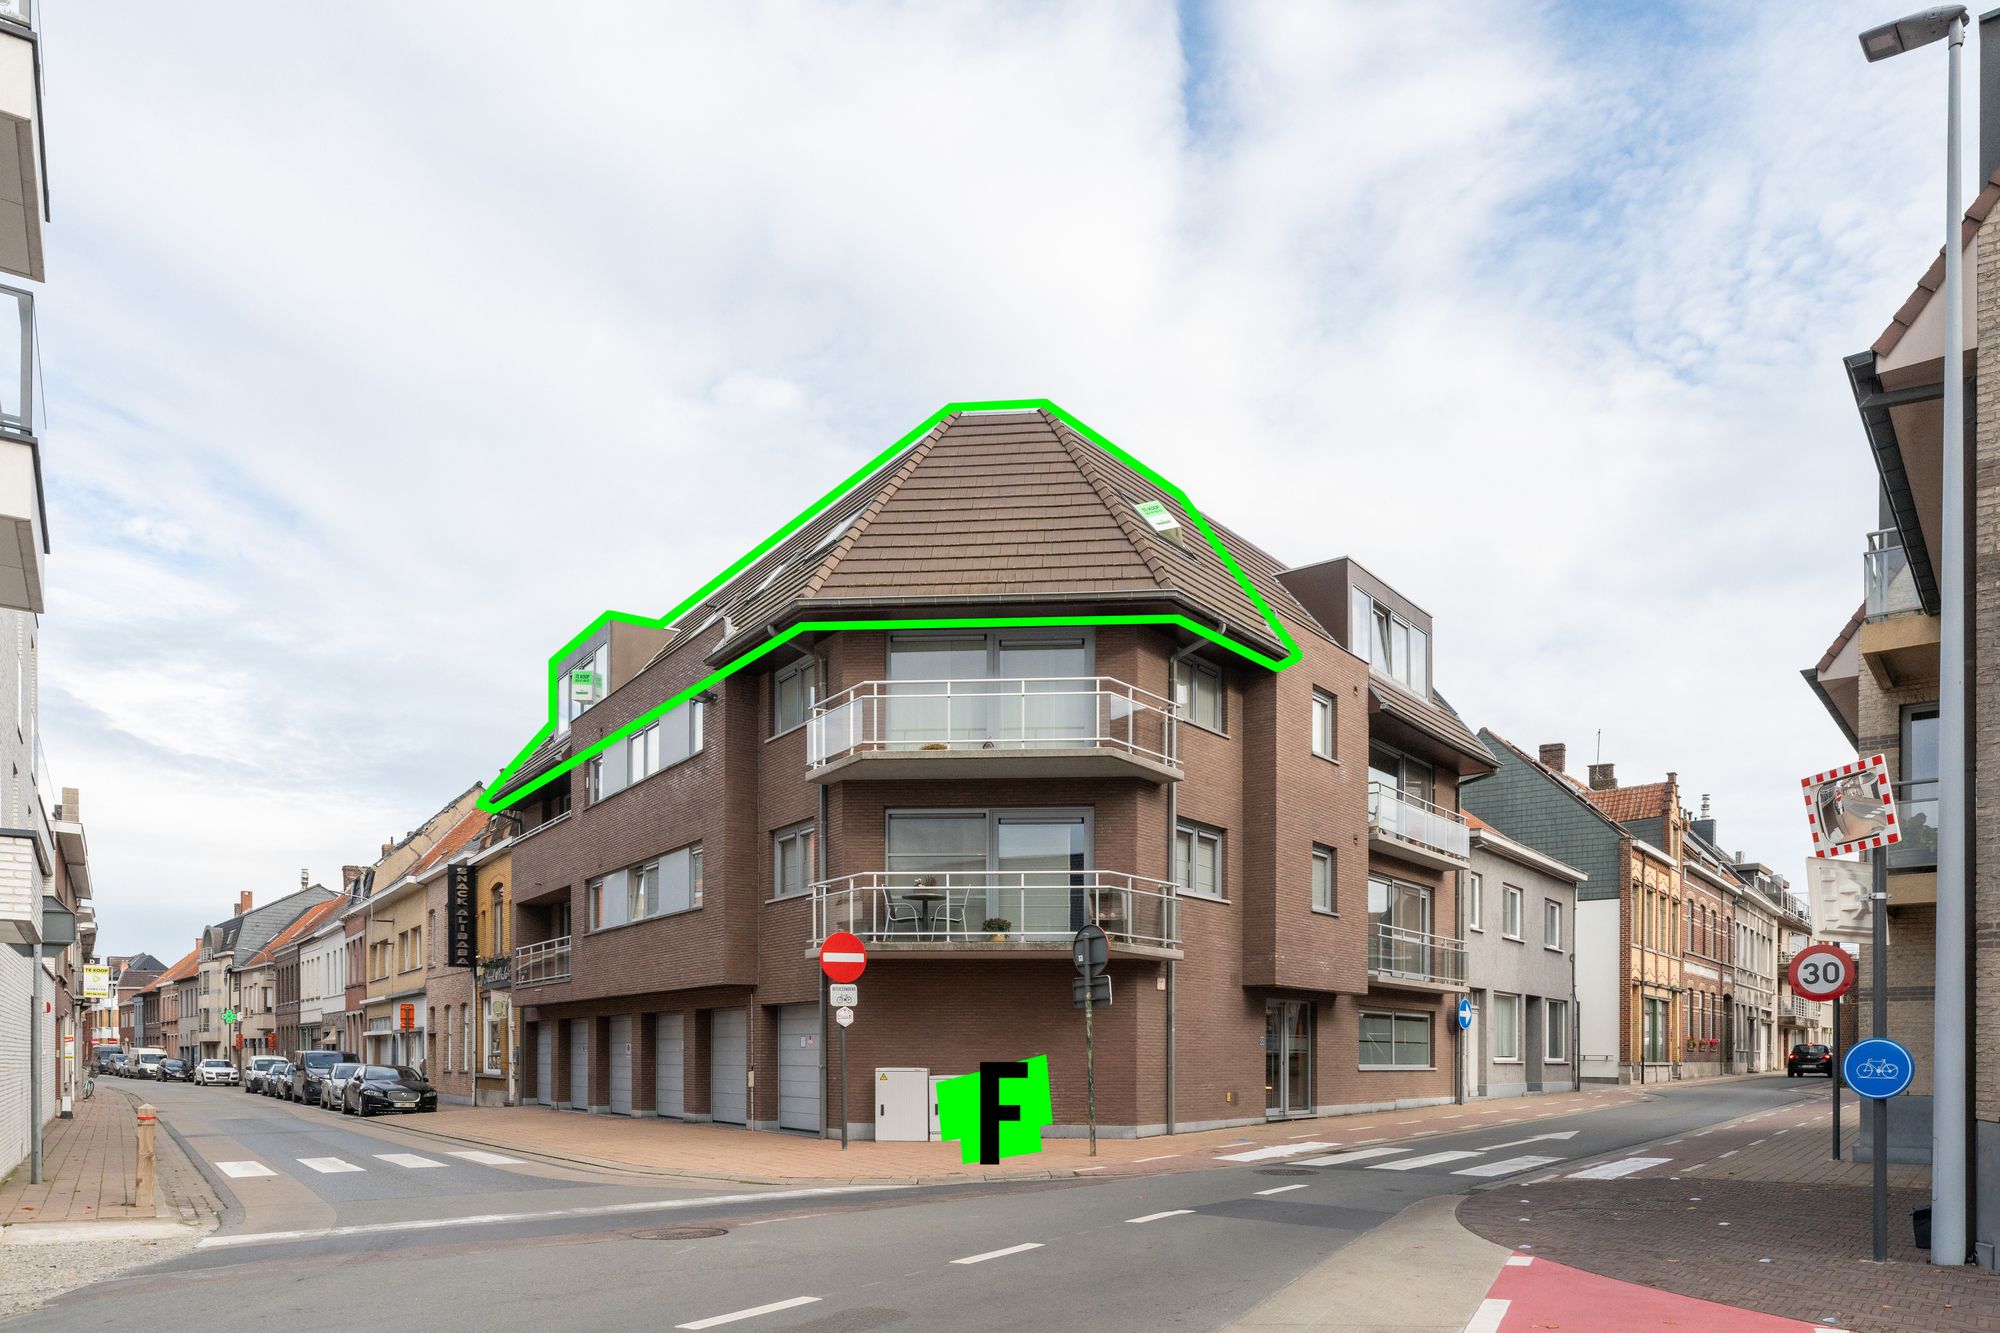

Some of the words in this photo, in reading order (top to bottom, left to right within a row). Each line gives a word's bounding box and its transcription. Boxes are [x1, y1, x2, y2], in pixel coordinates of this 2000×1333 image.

[456, 867, 468, 906] SNACK
[456, 909, 469, 965] ALIBABA
[1802, 961, 1840, 985] 30
